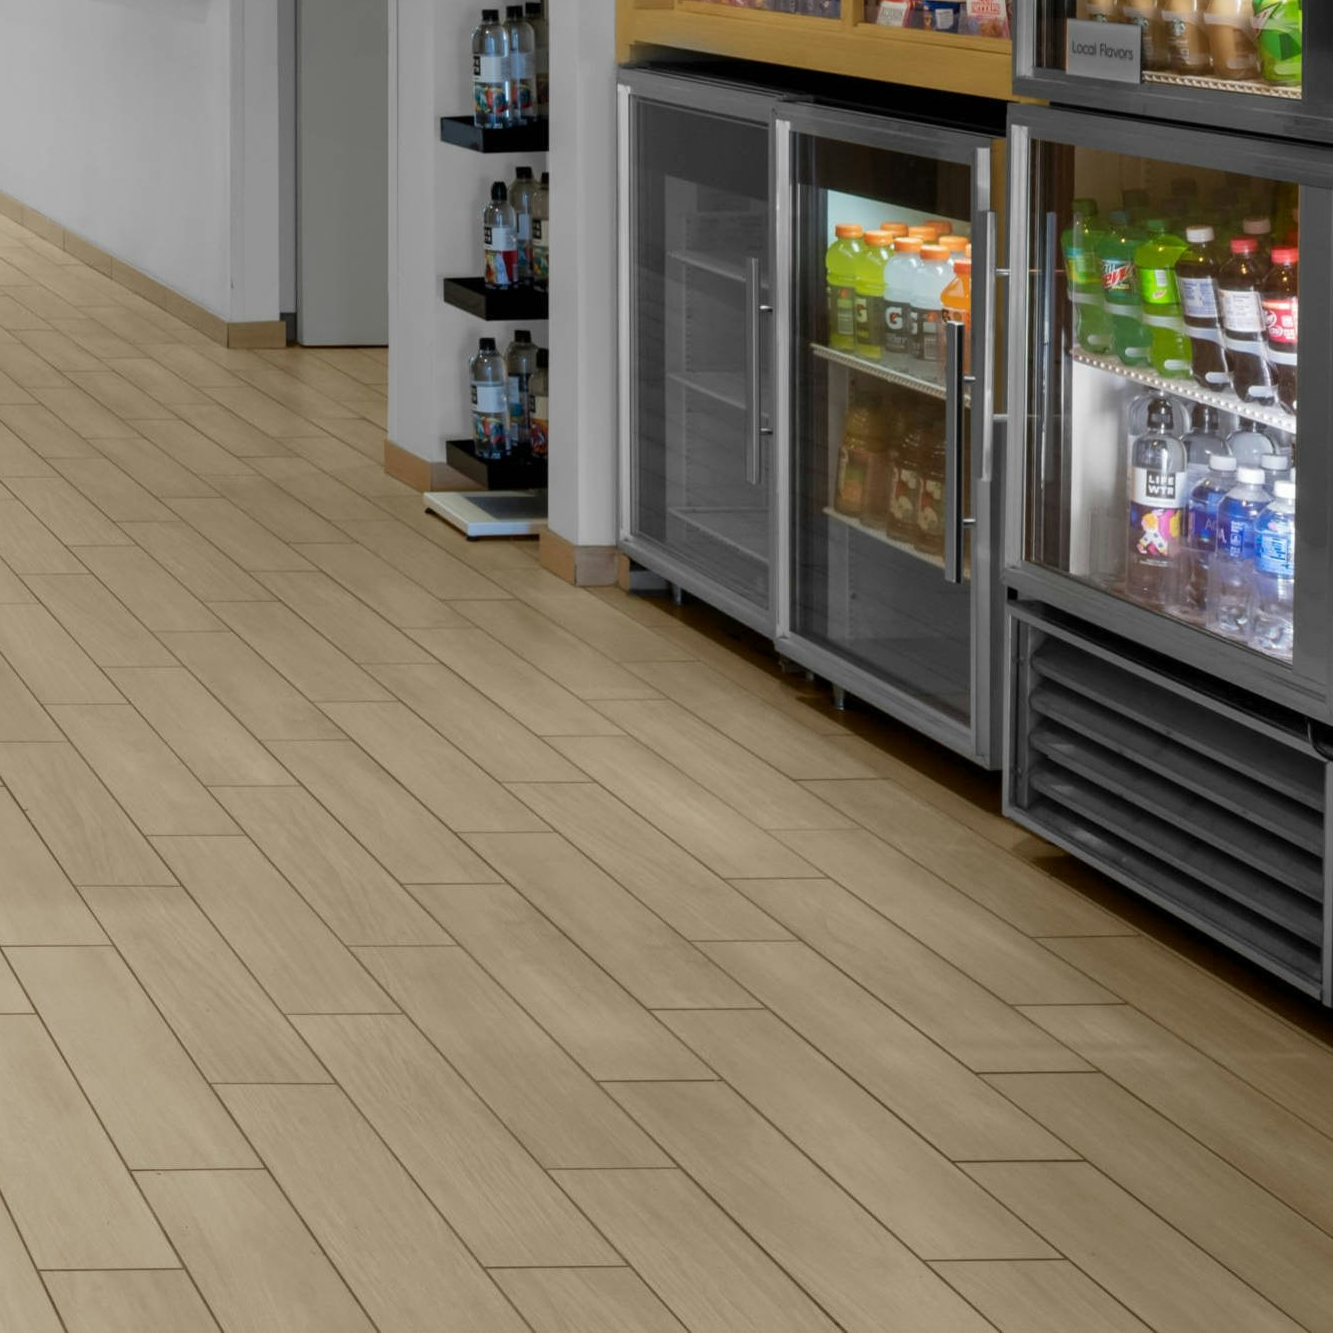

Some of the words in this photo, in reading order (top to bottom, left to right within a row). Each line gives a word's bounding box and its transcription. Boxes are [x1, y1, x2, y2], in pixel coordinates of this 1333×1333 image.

[1071, 39, 1097, 56] Local
[1099, 42, 1134, 61] Flavors
[885, 306, 903, 330] G
[1148, 475, 1174, 486] LIFE
[1148, 486, 1174, 497] WTR
